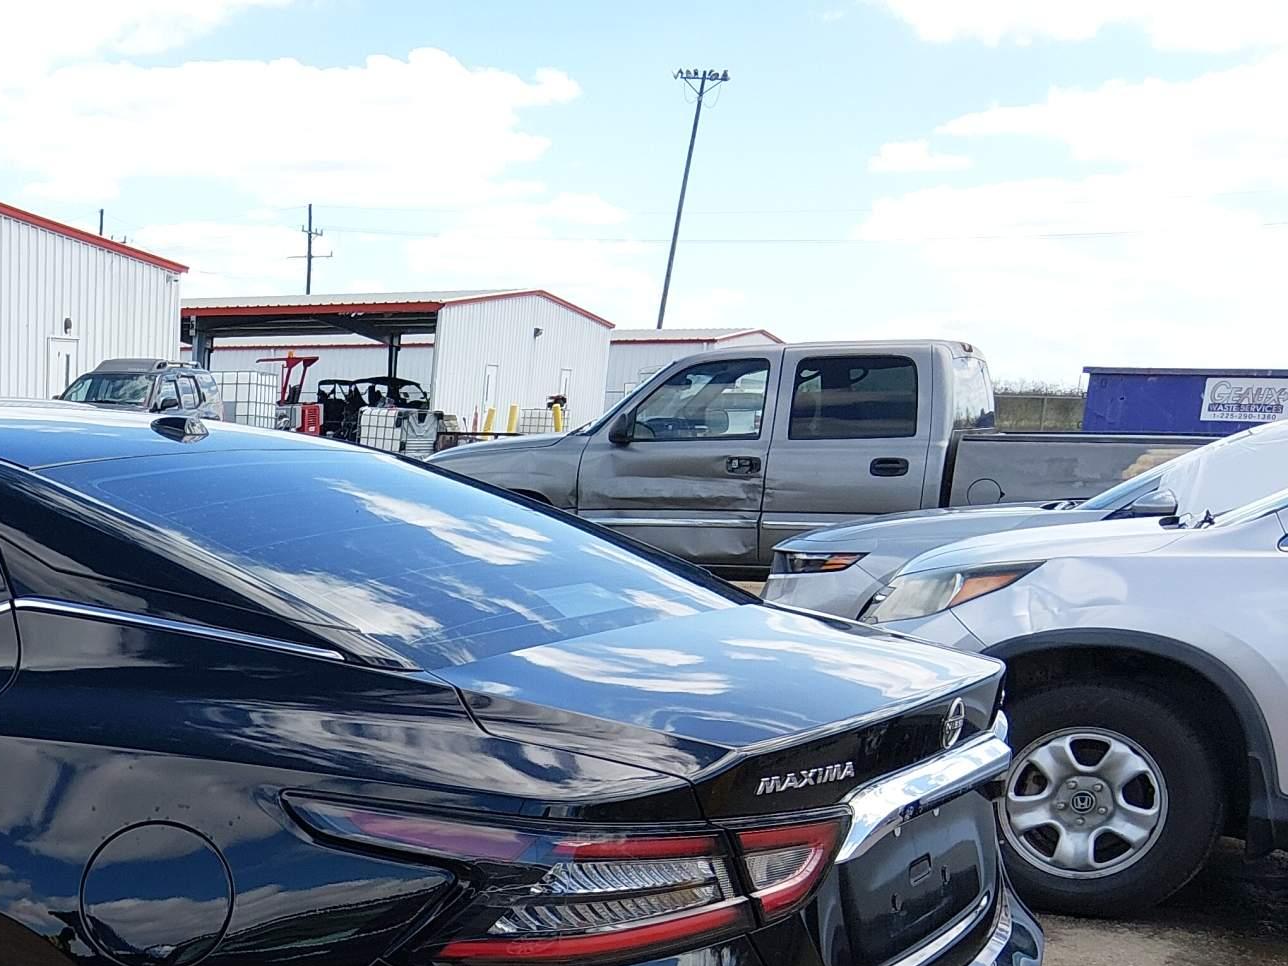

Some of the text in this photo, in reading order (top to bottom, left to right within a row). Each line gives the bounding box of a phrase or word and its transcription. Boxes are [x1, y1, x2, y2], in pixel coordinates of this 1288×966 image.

[1209, 404, 1282, 413] WASTE SERVICES
[754, 761, 855, 796] MAXIMA
